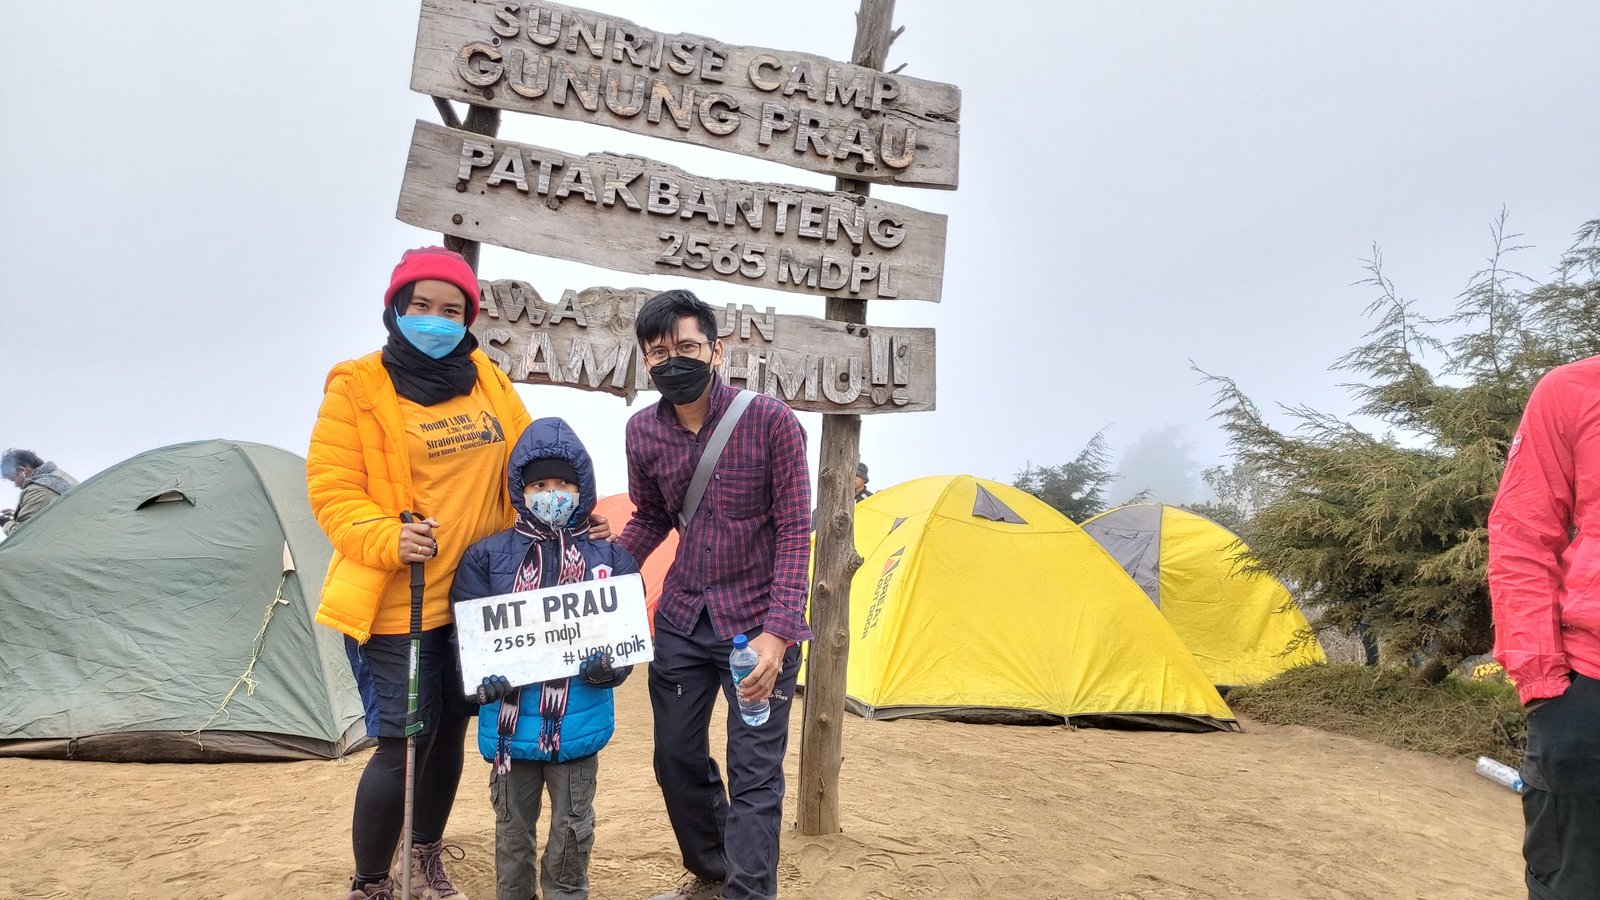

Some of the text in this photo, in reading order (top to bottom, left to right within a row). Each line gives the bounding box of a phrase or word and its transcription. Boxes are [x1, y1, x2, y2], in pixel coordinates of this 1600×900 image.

[491, 5, 902, 112] SUNRISE CAMP
[456, 41, 918, 169] GUNUNG PRAU
[457, 138, 907, 249] PATAKBANTENG
[655, 229, 898, 298] 2565 MDPL
[478, 279, 588, 327] AWA
[419, 413, 472, 433] Mount LAWU
[426, 430, 482, 450] Stratovolcano
[482, 585, 618, 632] MT PRAU
[870, 572, 894, 629] GREAT
[494, 622, 581, 653] 2565 mdpl
[616, 634, 646, 659] apik
